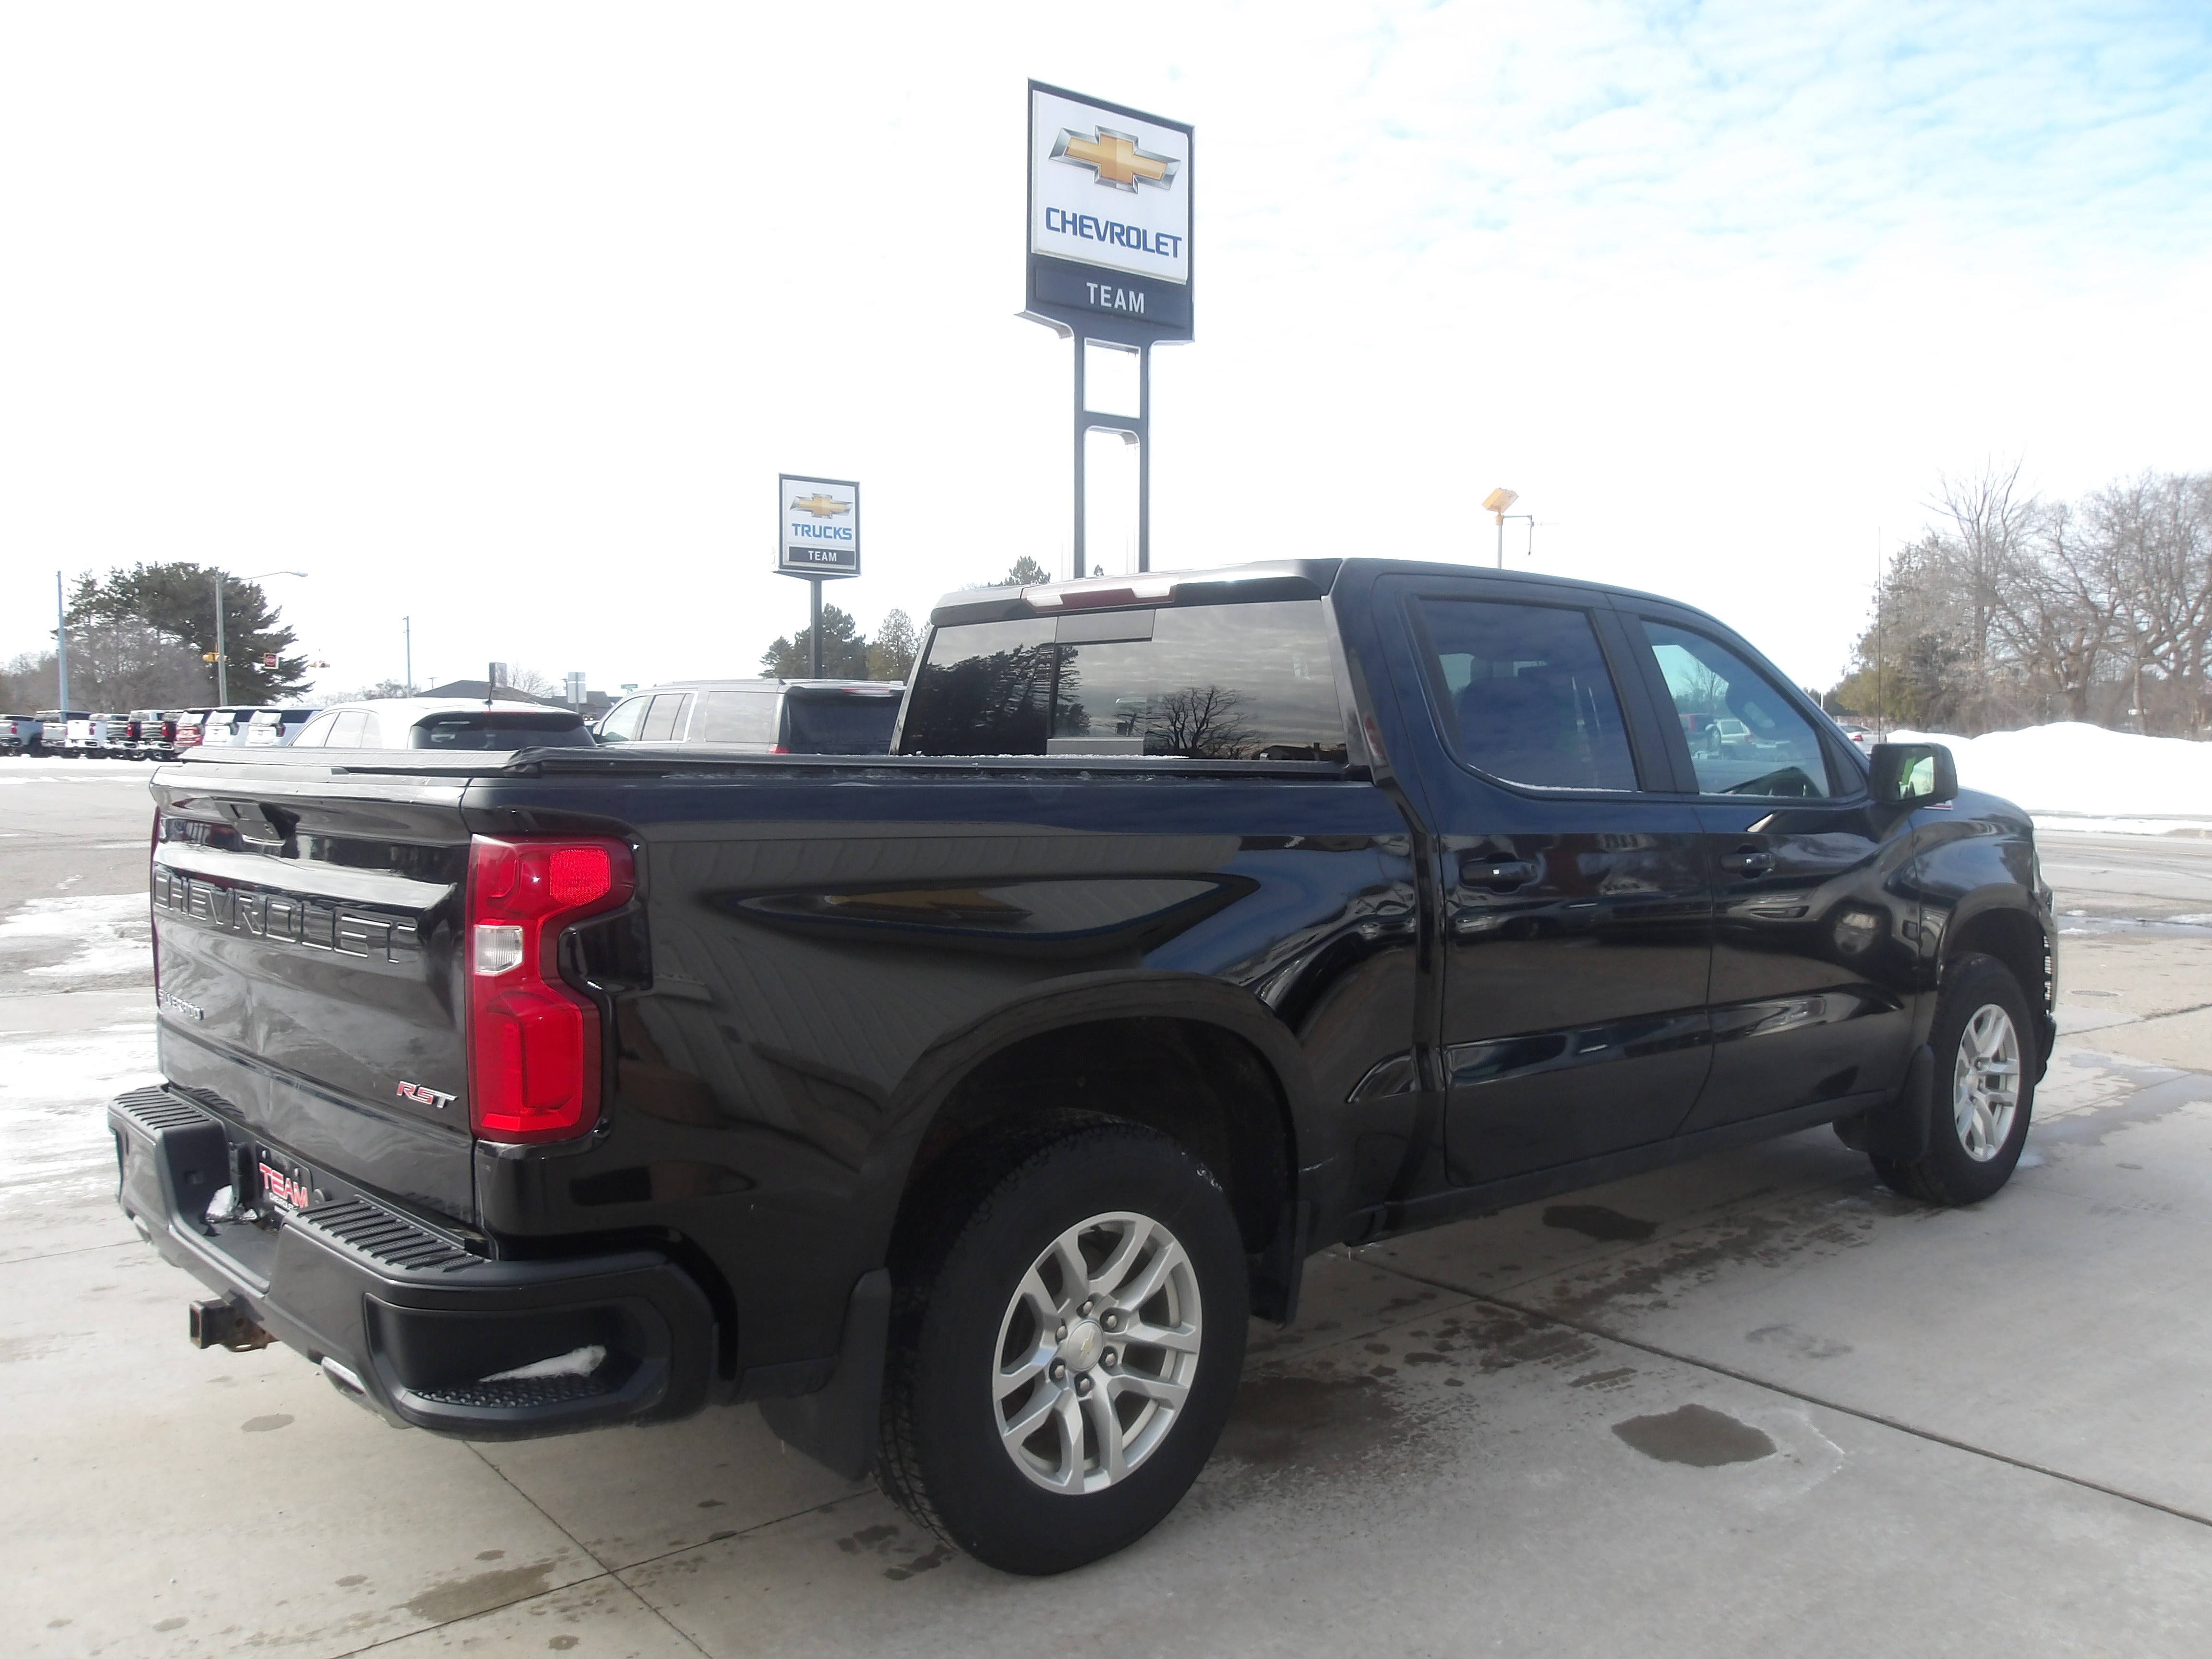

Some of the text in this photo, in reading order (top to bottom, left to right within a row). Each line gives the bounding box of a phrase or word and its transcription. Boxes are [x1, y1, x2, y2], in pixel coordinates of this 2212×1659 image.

[1046, 207, 1182, 258] CHEVROLET
[1086, 282, 1144, 313] TEAM
[792, 523, 852, 541] TRUCKS
[808, 551, 837, 562] TEAM
[154, 868, 419, 964] CHEVROLET
[396, 1080, 457, 1109] RST
[259, 1162, 309, 1209] TEAM
